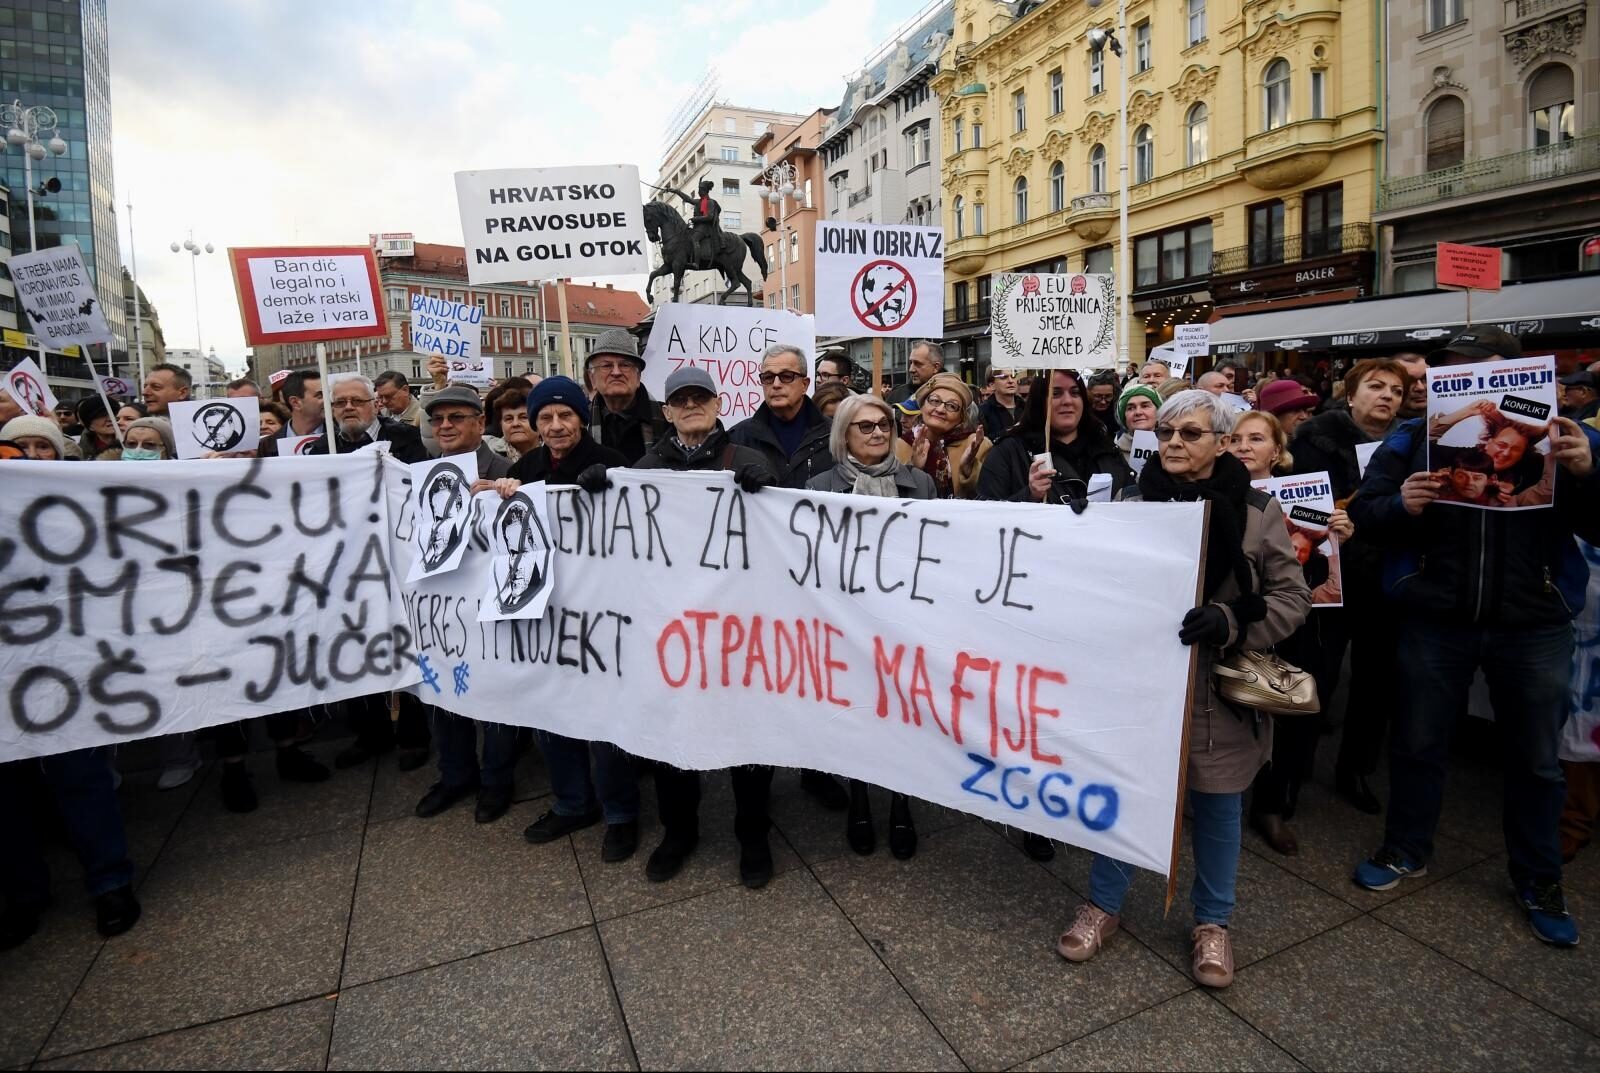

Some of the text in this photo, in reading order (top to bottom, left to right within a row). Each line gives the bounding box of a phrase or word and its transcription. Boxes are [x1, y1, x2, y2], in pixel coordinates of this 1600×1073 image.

[489, 183, 616, 205] HRVATSKO
[485, 212, 627, 234] PRAVOSUĐE
[475, 240, 643, 264] NA GOLI OTOK
[818, 227, 942, 259] JOHN OBRAZ
[13, 256, 81, 281] NE TREBA NAMA
[274, 259, 337, 273] Bandić
[1296, 267, 1335, 283] BASLER
[270, 274, 346, 292] legalno i
[1047, 277, 1066, 294] EU
[46, 307, 77, 322] MILANA
[1016, 297, 1102, 314] PRIJESTOLNICA
[278, 309, 369, 325] laže i vara
[417, 315, 461, 337] DOSTA
[1038, 314, 1076, 331] SMEĆA
[414, 331, 471, 359] KRAĐE
[667, 324, 686, 354] A
[699, 324, 738, 353] KAD
[1031, 336, 1084, 356] ZAGREB
[1431, 370, 1553, 393] GLUP I GLUPLJI
[1503, 399, 1548, 416] KONFLIKT
[1280, 483, 1330, 500] GLUPLJI
[1293, 509, 1329, 523] KONFLIKT
[699, 486, 750, 571] ZA
[788, 498, 950, 605] SMEĆE
[975, 526, 1043, 611] JE
[656, 608, 851, 708] OTPADNE
[872, 634, 1068, 766] MAFIJE
[960, 751, 1120, 832] ZCGO
